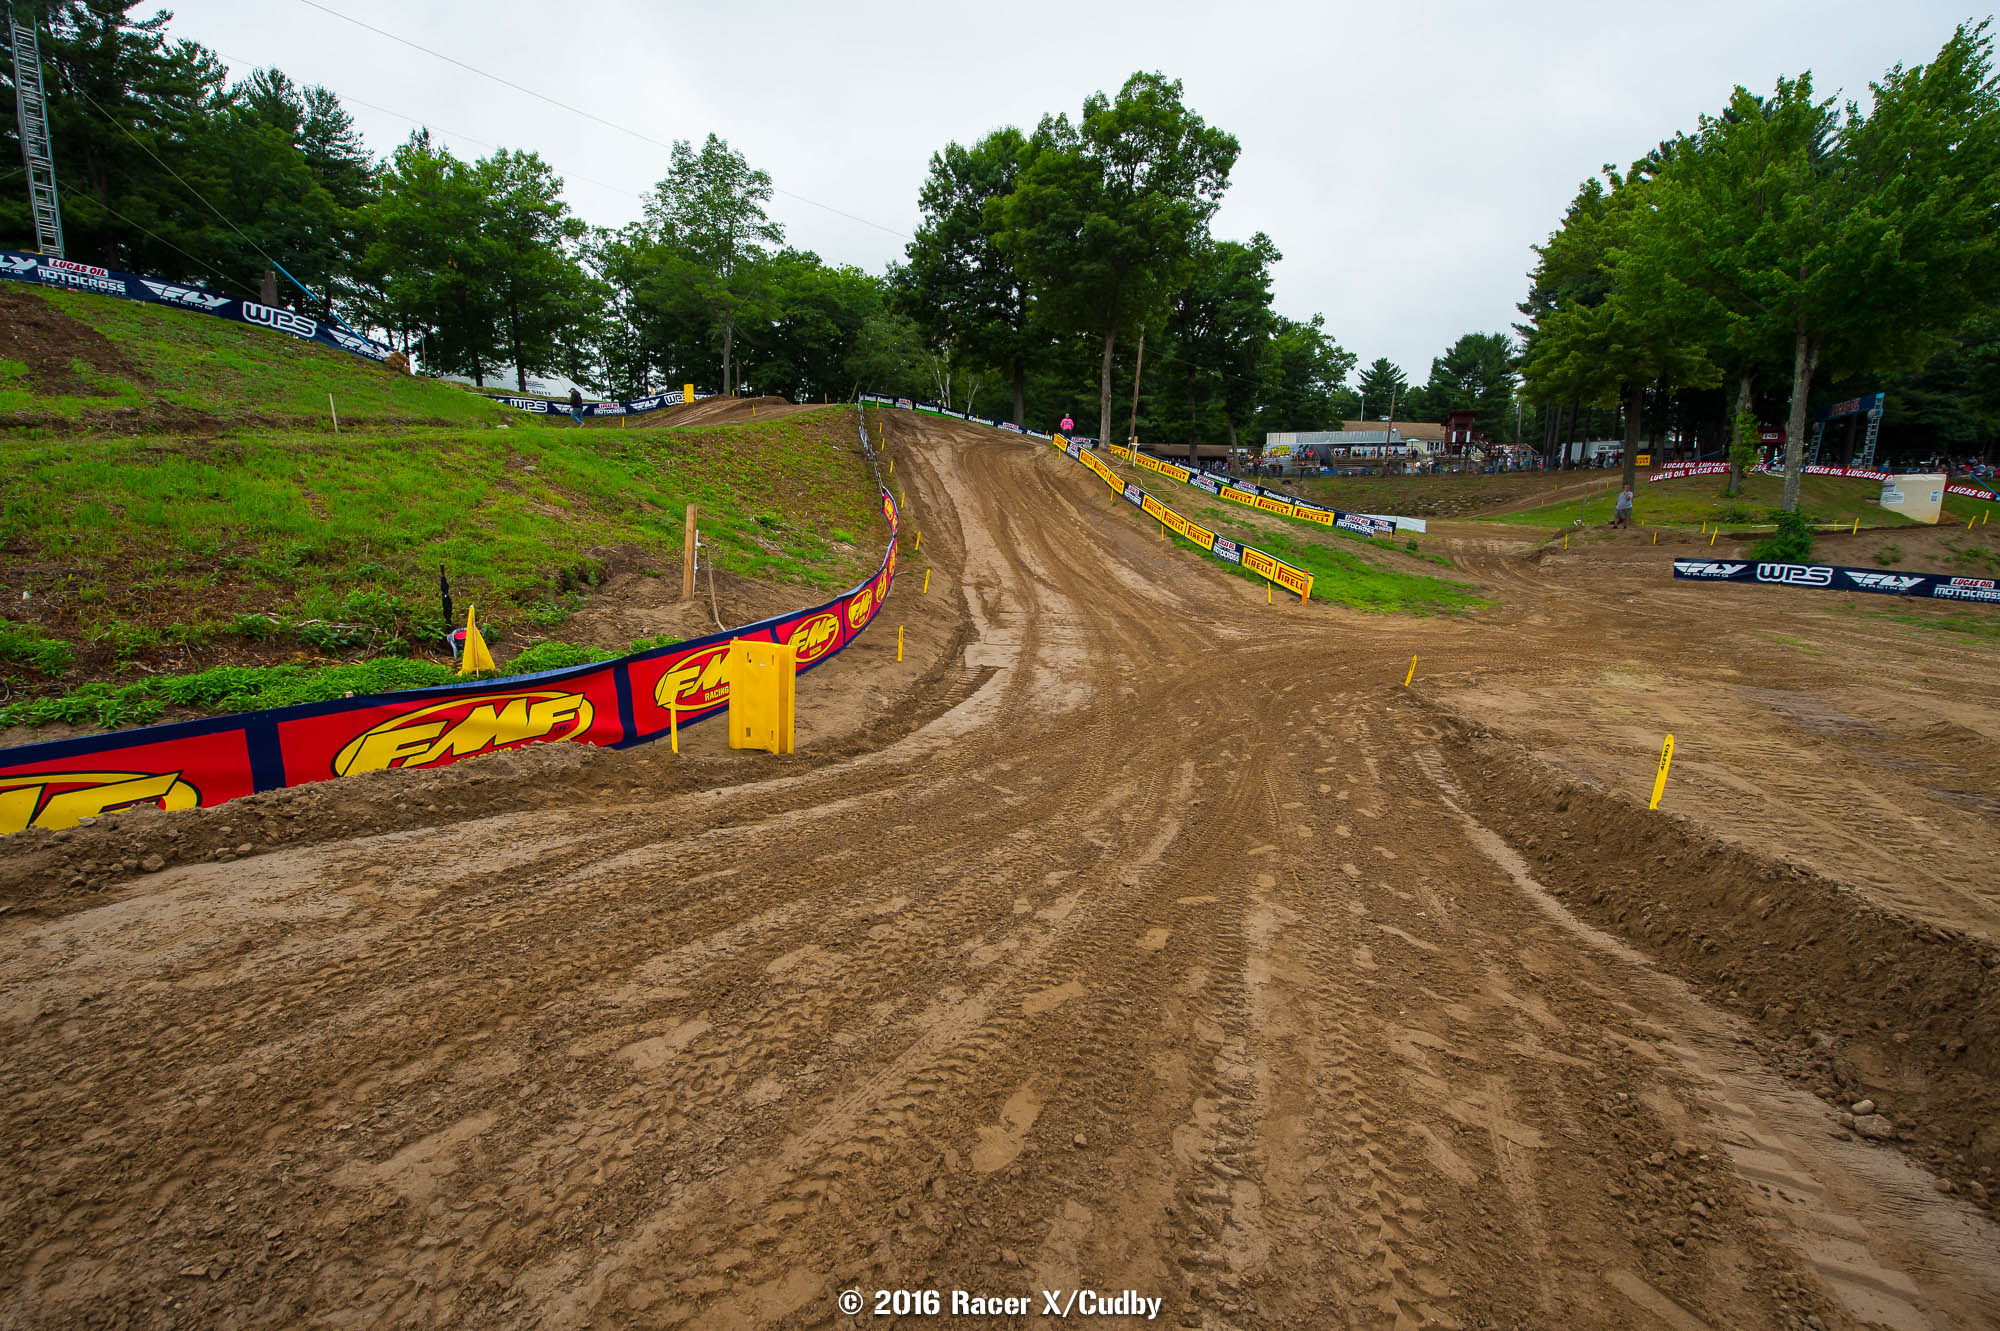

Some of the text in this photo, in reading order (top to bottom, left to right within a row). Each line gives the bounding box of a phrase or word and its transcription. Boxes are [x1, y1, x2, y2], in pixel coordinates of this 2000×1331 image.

[52, 259, 88, 273] LUCAS
[90, 267, 107, 277] OIL
[139, 280, 231, 307] FLY
[243, 301, 318, 338] WPS
[510, 398, 548, 413] WPS
[664, 393, 685, 406] WP
[1160, 463, 1187, 480] PIRELLI
[1650, 472, 1673, 481] LUCAS
[1830, 468, 1843, 476] OIL
[1223, 488, 1252, 504] PIRELLI
[1263, 489, 1291, 503] Kawasaki
[1947, 485, 1976, 496] LUCAS
[1976, 490, 1993, 499] OIL
[1144, 497, 1161, 516] PIRELLI
[1258, 498, 1289, 514] PIRELLI
[1164, 510, 1184, 532] PIRELLI
[1296, 508, 1330, 523] PIRELLI
[1187, 525, 1211, 546] PIRELLI
[1336, 520, 1374, 534] MOTOCROSS
[1244, 551, 1273, 575] PIRELLI
[1674, 562, 1748, 574] FLY
[1277, 566, 1304, 591] PIRELL
[1757, 563, 1834, 586] WPS
[1844, 571, 1926, 588] FLY
[1951, 577, 1978, 586] LUCAS
[1934, 587, 2000, 600] MOTOCROSS
[789, 616, 838, 654] FMF
[656, 651, 731, 708] FM
[704, 685, 730, 702] RACING
[340, 692, 586, 778] FMF
